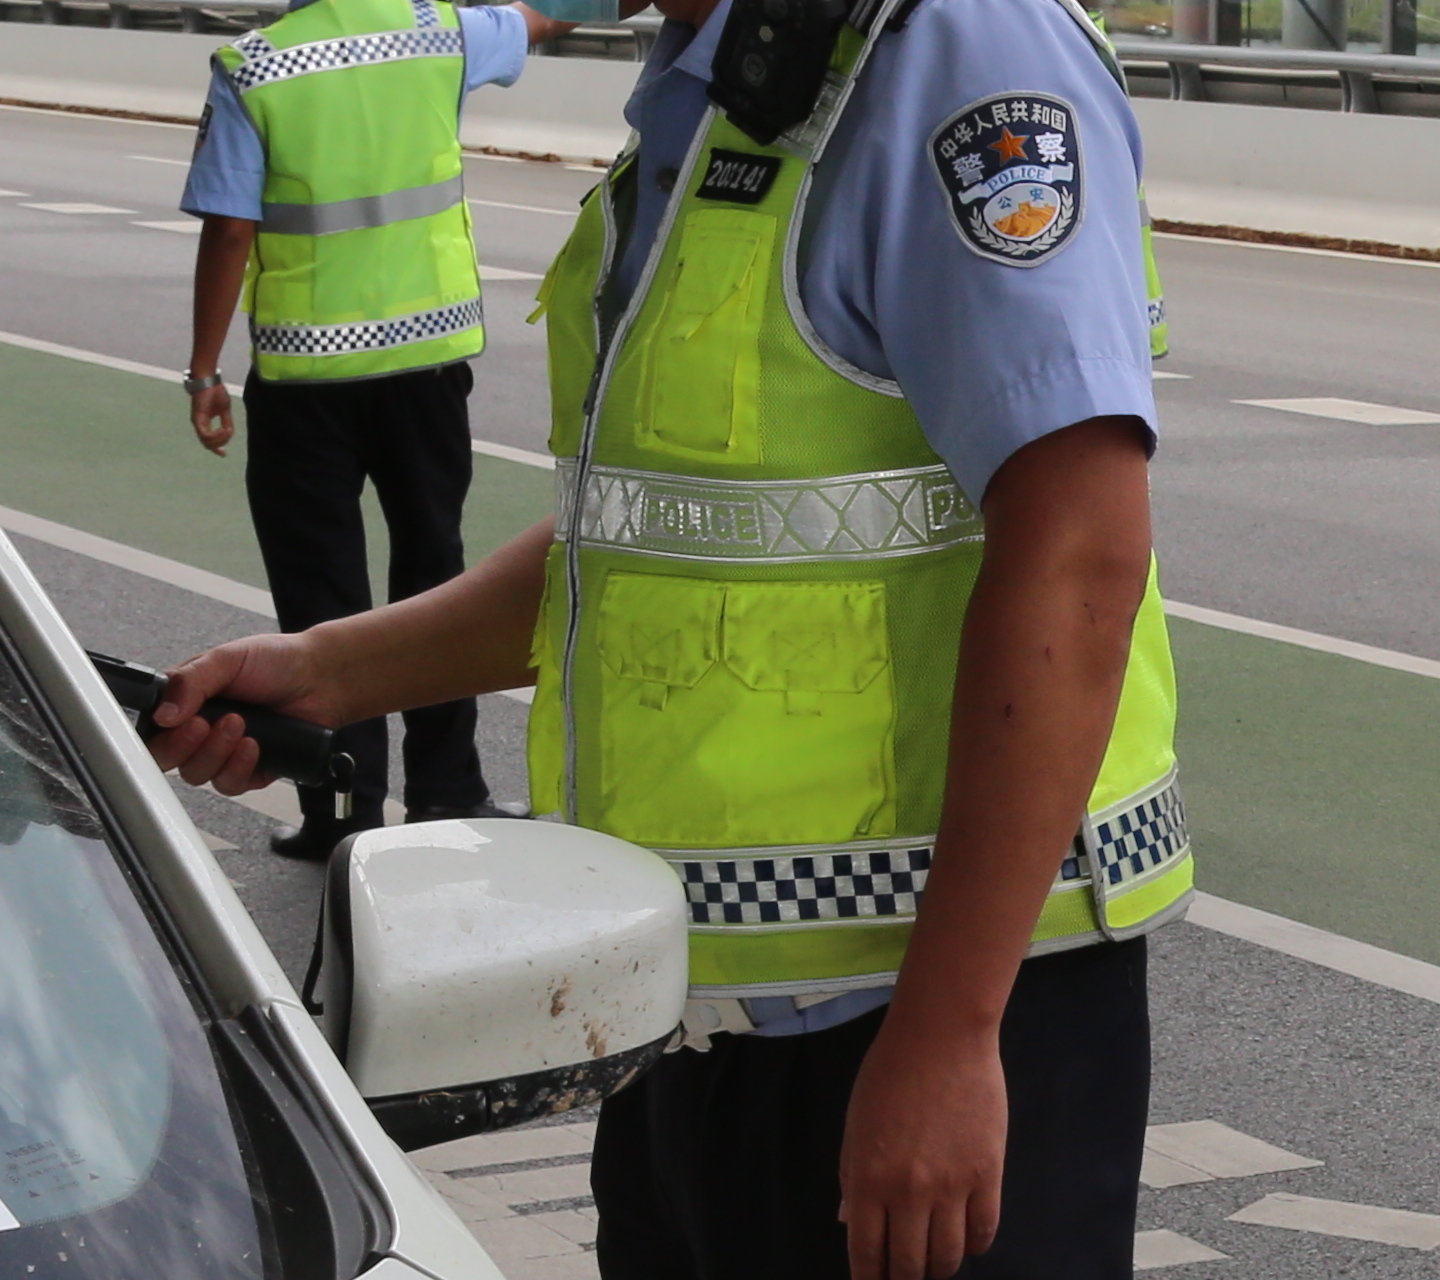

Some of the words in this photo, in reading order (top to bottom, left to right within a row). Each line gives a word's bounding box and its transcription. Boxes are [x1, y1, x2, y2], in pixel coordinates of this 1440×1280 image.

[940, 100, 1067, 159] 中华人民共和国
[986, 166, 1047, 193] POLICE
[996, 188, 1045, 210] 公安
[645, 498, 758, 542] POLICE
